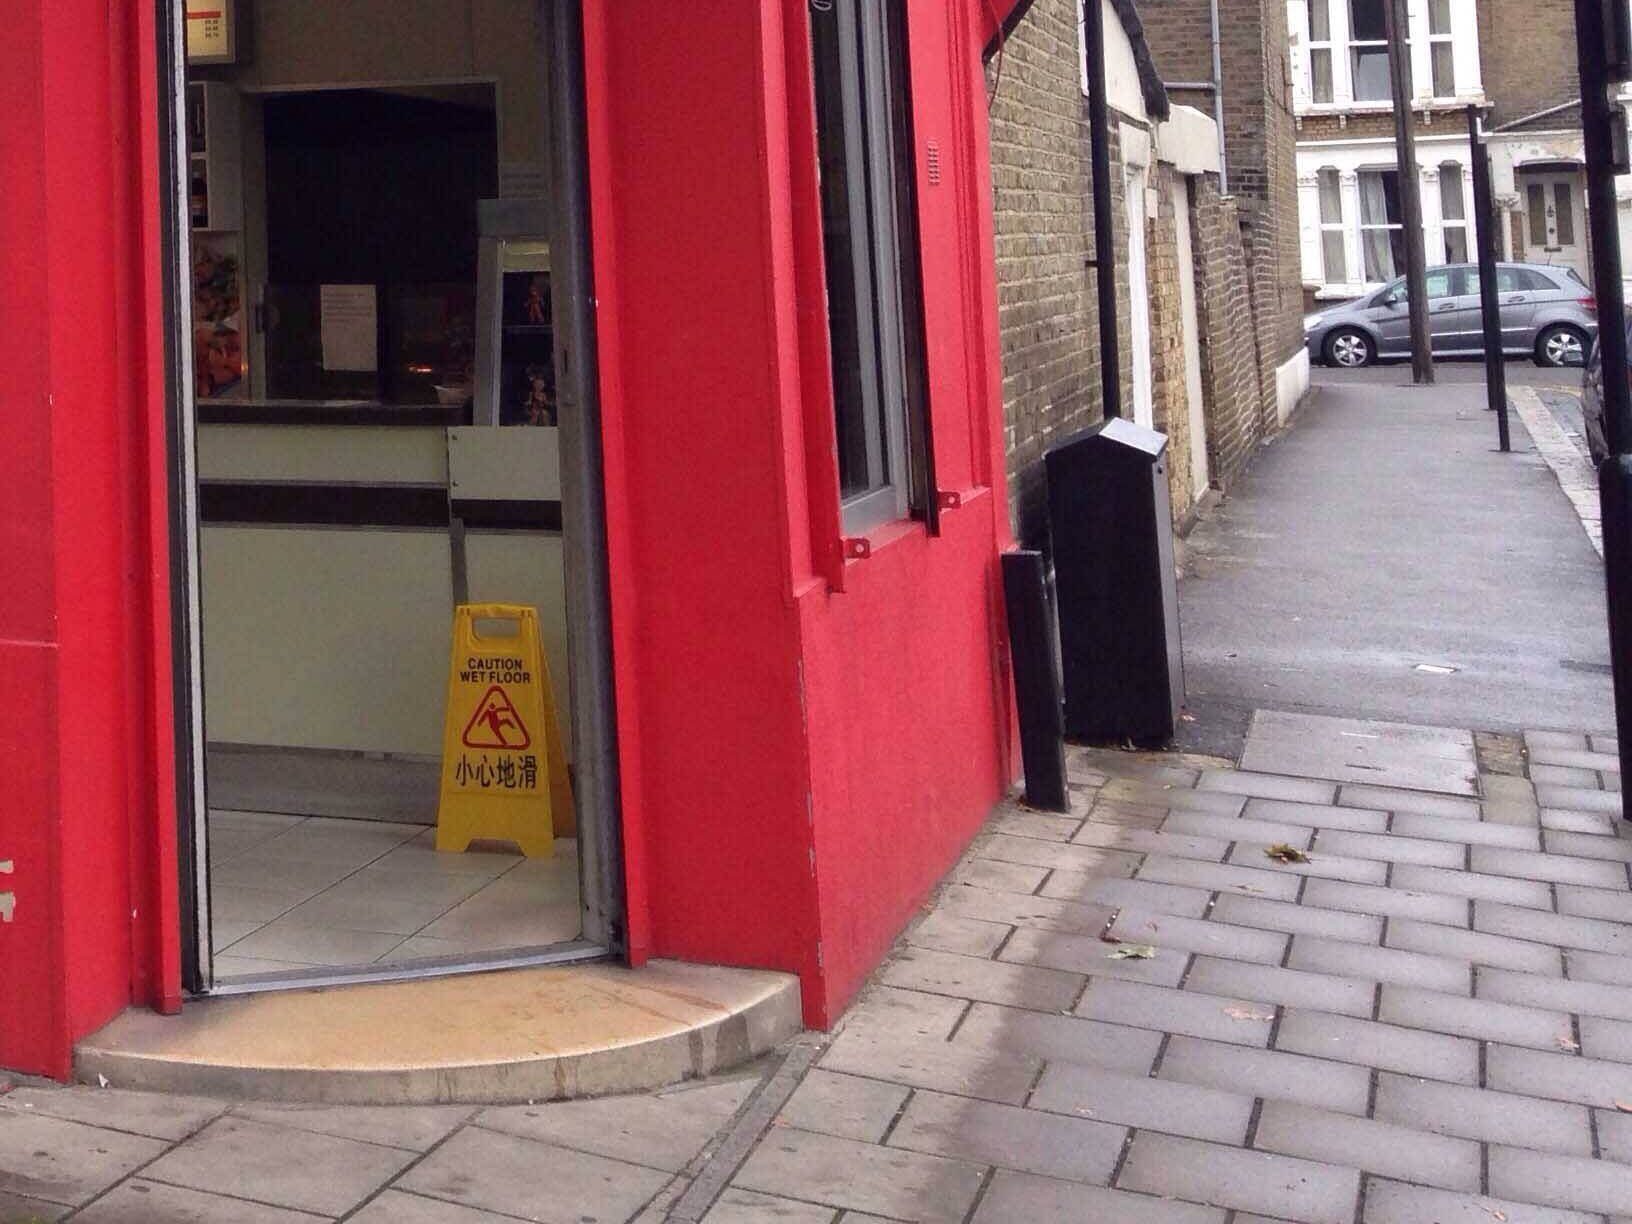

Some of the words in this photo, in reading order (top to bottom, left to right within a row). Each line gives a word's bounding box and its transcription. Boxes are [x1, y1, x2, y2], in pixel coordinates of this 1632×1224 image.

[468, 657, 523, 671] CAUTION
[460, 671, 485, 683] WET
[489, 671, 531, 684] FLOOR
[456, 754, 538, 789] 小心地滑
